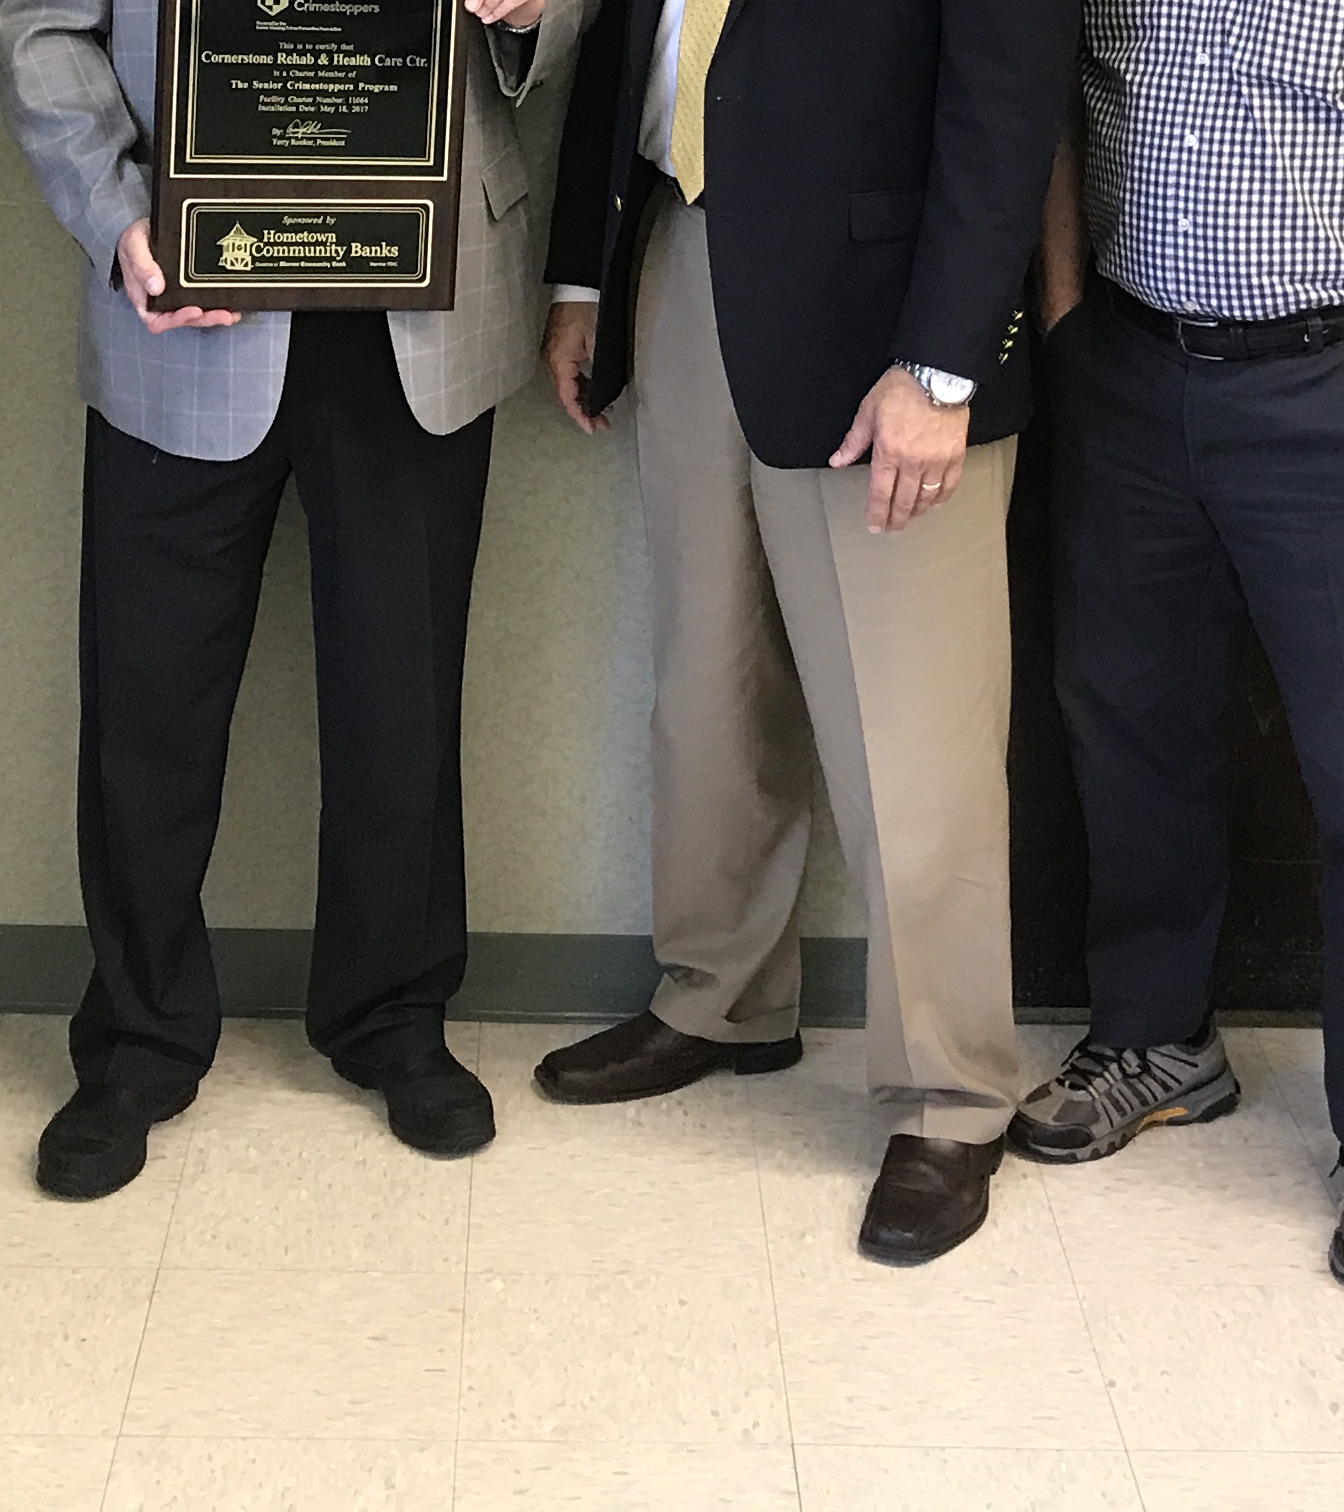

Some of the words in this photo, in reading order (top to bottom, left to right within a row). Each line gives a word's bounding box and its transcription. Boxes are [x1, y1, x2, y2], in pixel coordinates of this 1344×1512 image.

[293, 0, 380, 16] Crimestoppers
[278, 42, 294, 50] This
[315, 43, 337, 51] certify
[201, 51, 274, 65] Cornerstone
[276, 52, 314, 65] Rehab
[317, 53, 329, 65] &
[332, 53, 371, 66] Health
[374, 54, 403, 67] Care
[406, 55, 428, 68] Ctr.
[317, 70, 346, 78] Member
[348, 70, 356, 78] of
[230, 80, 248, 89] The
[252, 80, 283, 90] Senior
[287, 81, 354, 92] Crimestoppers
[358, 82, 398, 94] Program
[258, 104, 296, 112] Installation
[320, 105, 336, 114] May
[351, 105, 369, 113] 2017
[282, 215, 324, 225] Sponsored
[326, 215, 337, 225] by
[263, 229, 337, 243] Hometown
[251, 242, 347, 260] Community
[350, 242, 399, 257] Banks
